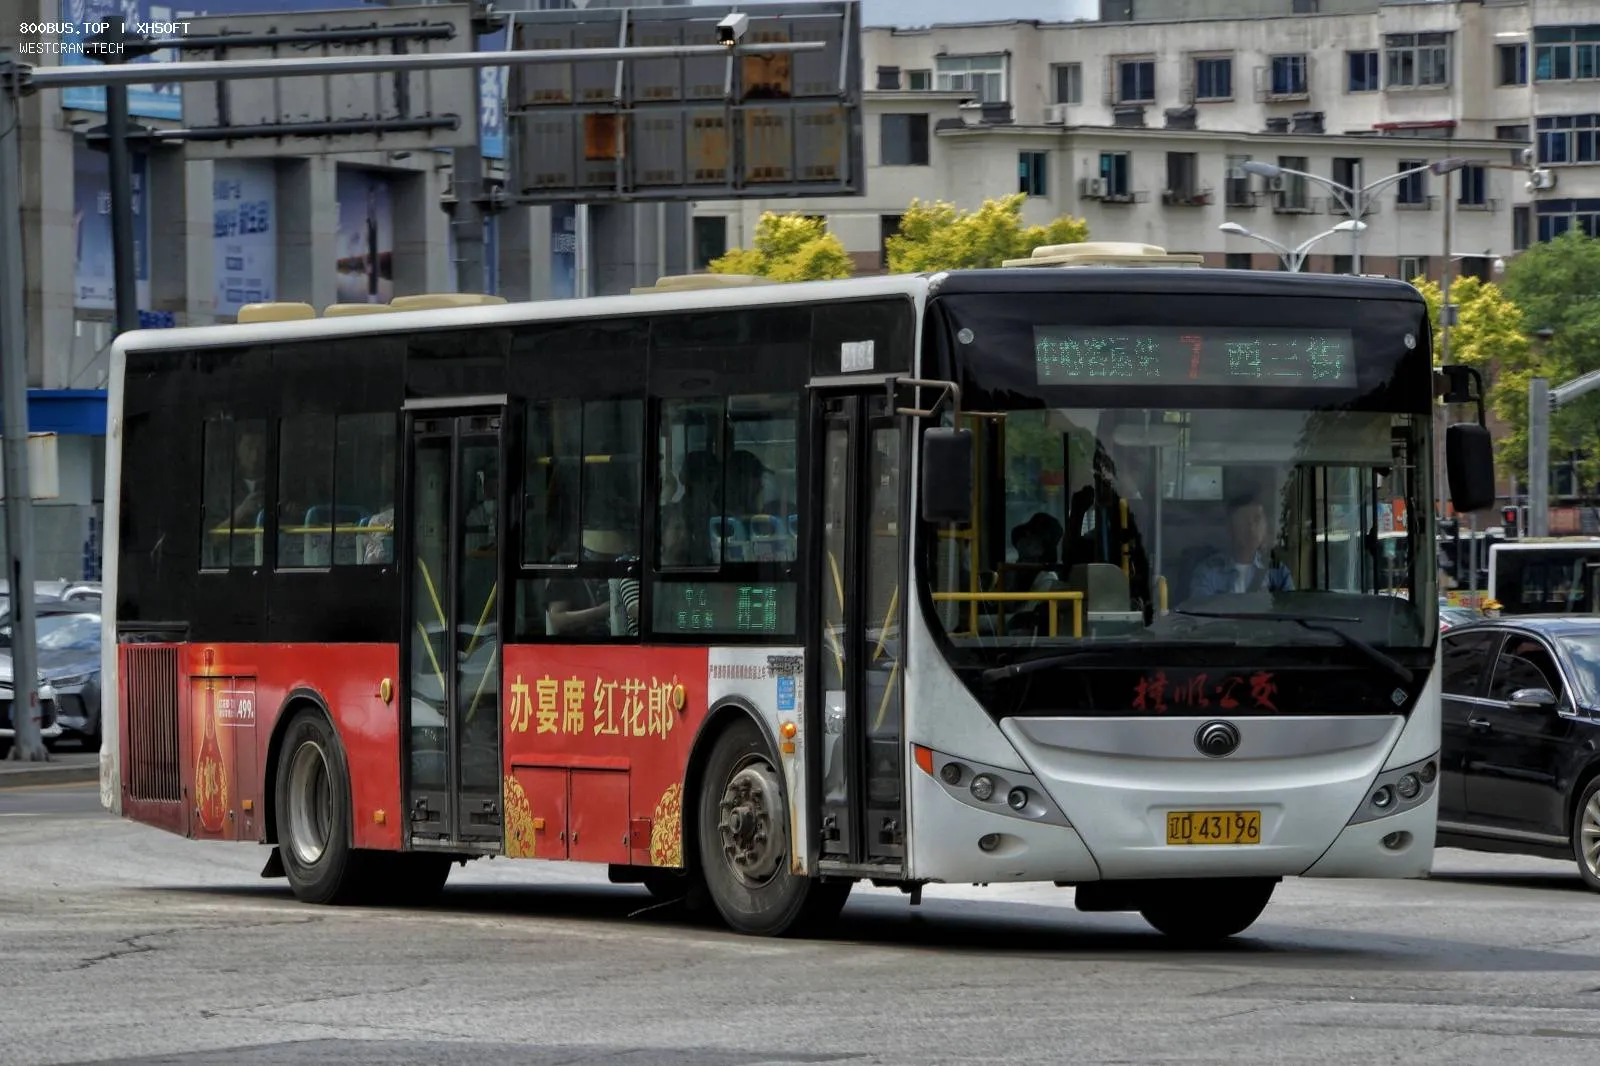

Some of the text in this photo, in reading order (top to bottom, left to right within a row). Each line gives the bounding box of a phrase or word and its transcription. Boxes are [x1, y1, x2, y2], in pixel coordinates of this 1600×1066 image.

[509, 674, 674, 740] 办宴席 红花郎
